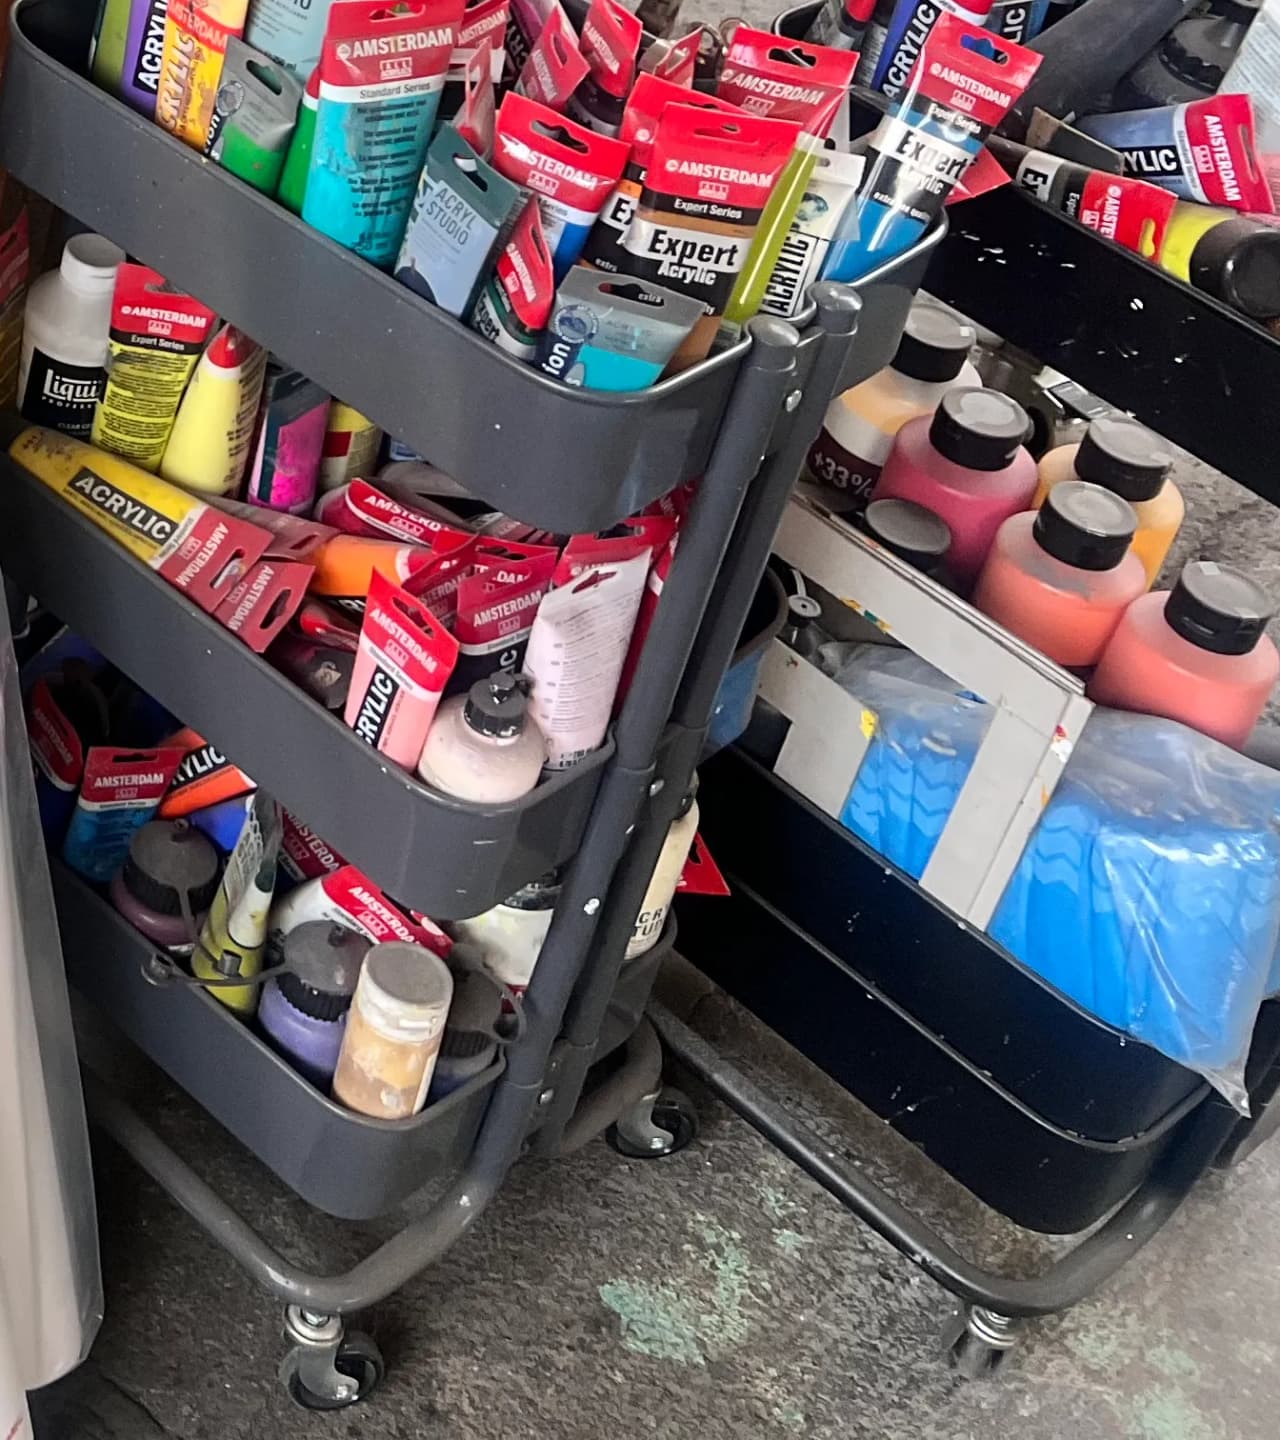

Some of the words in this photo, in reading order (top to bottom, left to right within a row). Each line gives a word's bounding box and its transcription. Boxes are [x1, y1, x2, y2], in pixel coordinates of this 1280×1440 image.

[352, 28, 452, 58] AMSTERDAM
[457, 10, 507, 46] AMSTERDAM
[881, 3, 936, 98] ACRYLIC
[360, 84, 401, 99] Standard
[403, 82, 431, 95] Series
[731, 73, 827, 106] AMSTERDAM
[939, 67, 1012, 108] AMSTERDAM
[503, 142, 598, 191] STERDAM
[679, 161, 774, 188] AMSTERDAM
[1203, 114, 1242, 202] AMSTERDAM
[426, 202, 469, 245] STUDIO
[436, 188, 476, 231] ACRYL
[674, 198, 707, 214] Expert
[709, 204, 742, 219] Series
[648, 229, 738, 266] Expert
[657, 263, 717, 285] Acrylic
[762, 236, 809, 313] ACRYLIC
[131, 309, 207, 328] AMSTERDAM
[131, 335, 157, 347] Expert
[158, 339, 185, 350] Series
[815, 451, 872, 498] +33%
[75, 476, 173, 540] ACRYLIC
[175, 522, 229, 587] AMSTERDAM
[228, 566, 275, 632] AMSTERDAM
[473, 590, 541, 628] AMSTERDAM
[369, 608, 438, 673] AMSTERDAM
[94, 773, 164, 788] AMSTERDAM
